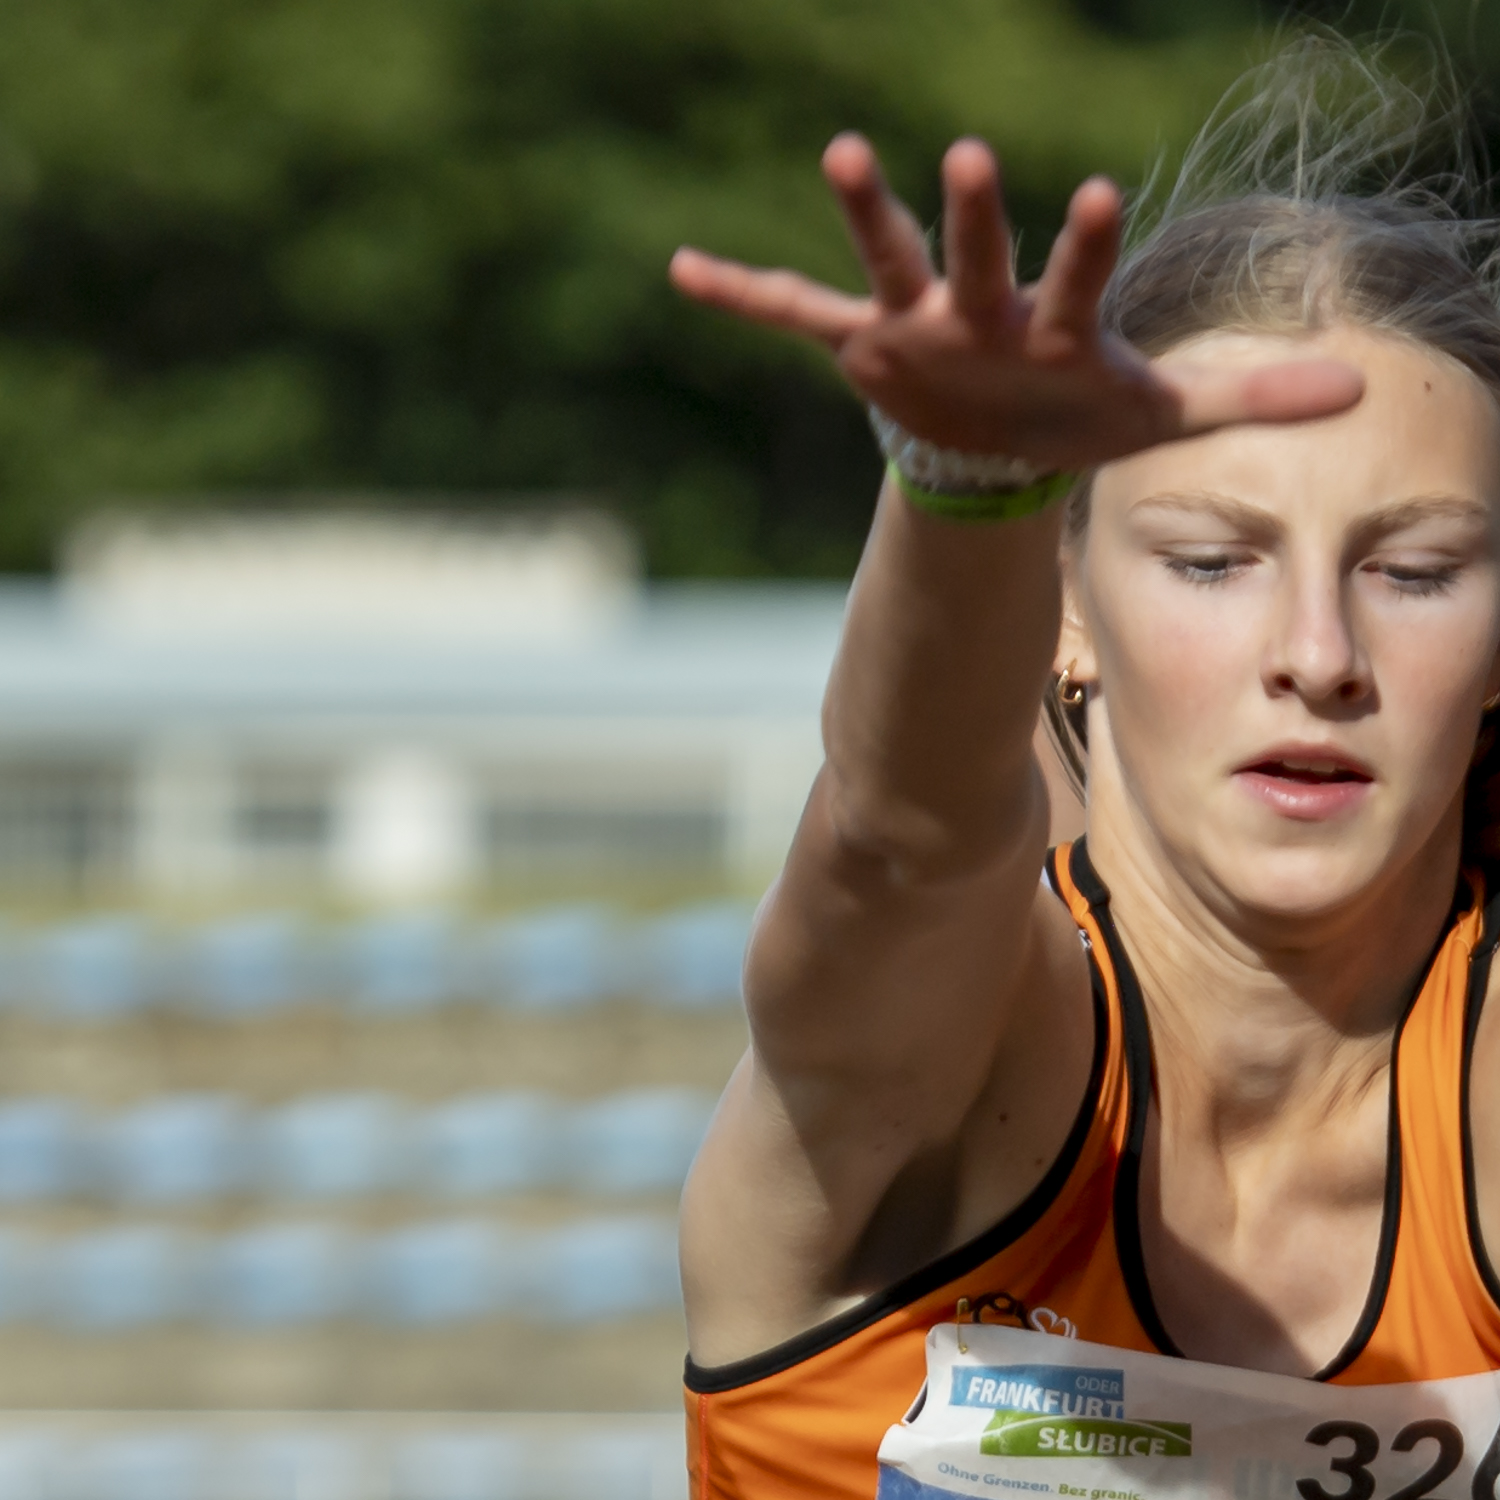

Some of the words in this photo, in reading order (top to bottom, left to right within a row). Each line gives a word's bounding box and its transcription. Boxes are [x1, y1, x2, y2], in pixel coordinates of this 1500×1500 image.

[966, 1375, 1124, 1420] FRANKFURT
[1075, 1374, 1120, 1394] ODER
[1036, 1426, 1167, 1457] SŁUBICE
[937, 1461, 980, 1482] Ohne
[983, 1472, 1054, 1494] Grenzen.
[1058, 1483, 1088, 1498] Bez
